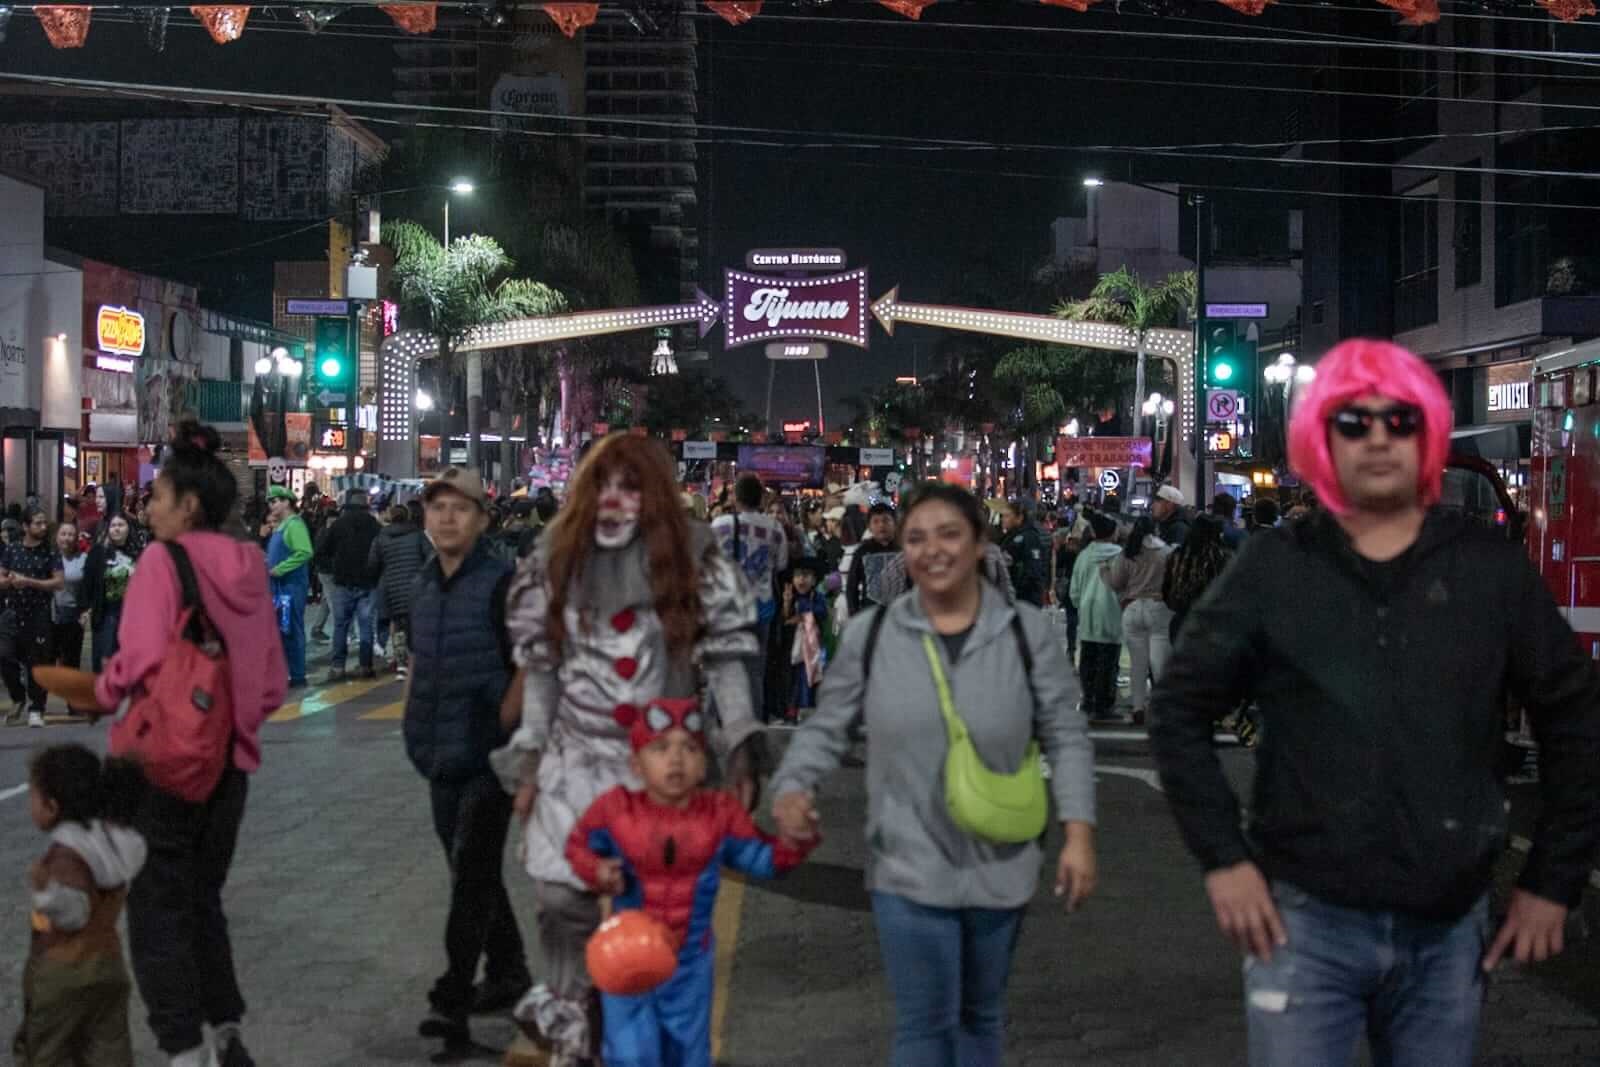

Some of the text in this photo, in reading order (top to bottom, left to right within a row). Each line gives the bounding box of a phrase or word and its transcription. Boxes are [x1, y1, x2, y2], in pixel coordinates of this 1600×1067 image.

[743, 287, 850, 328] Tijuana
[1065, 453, 1143, 463] POR TRABAJOS
